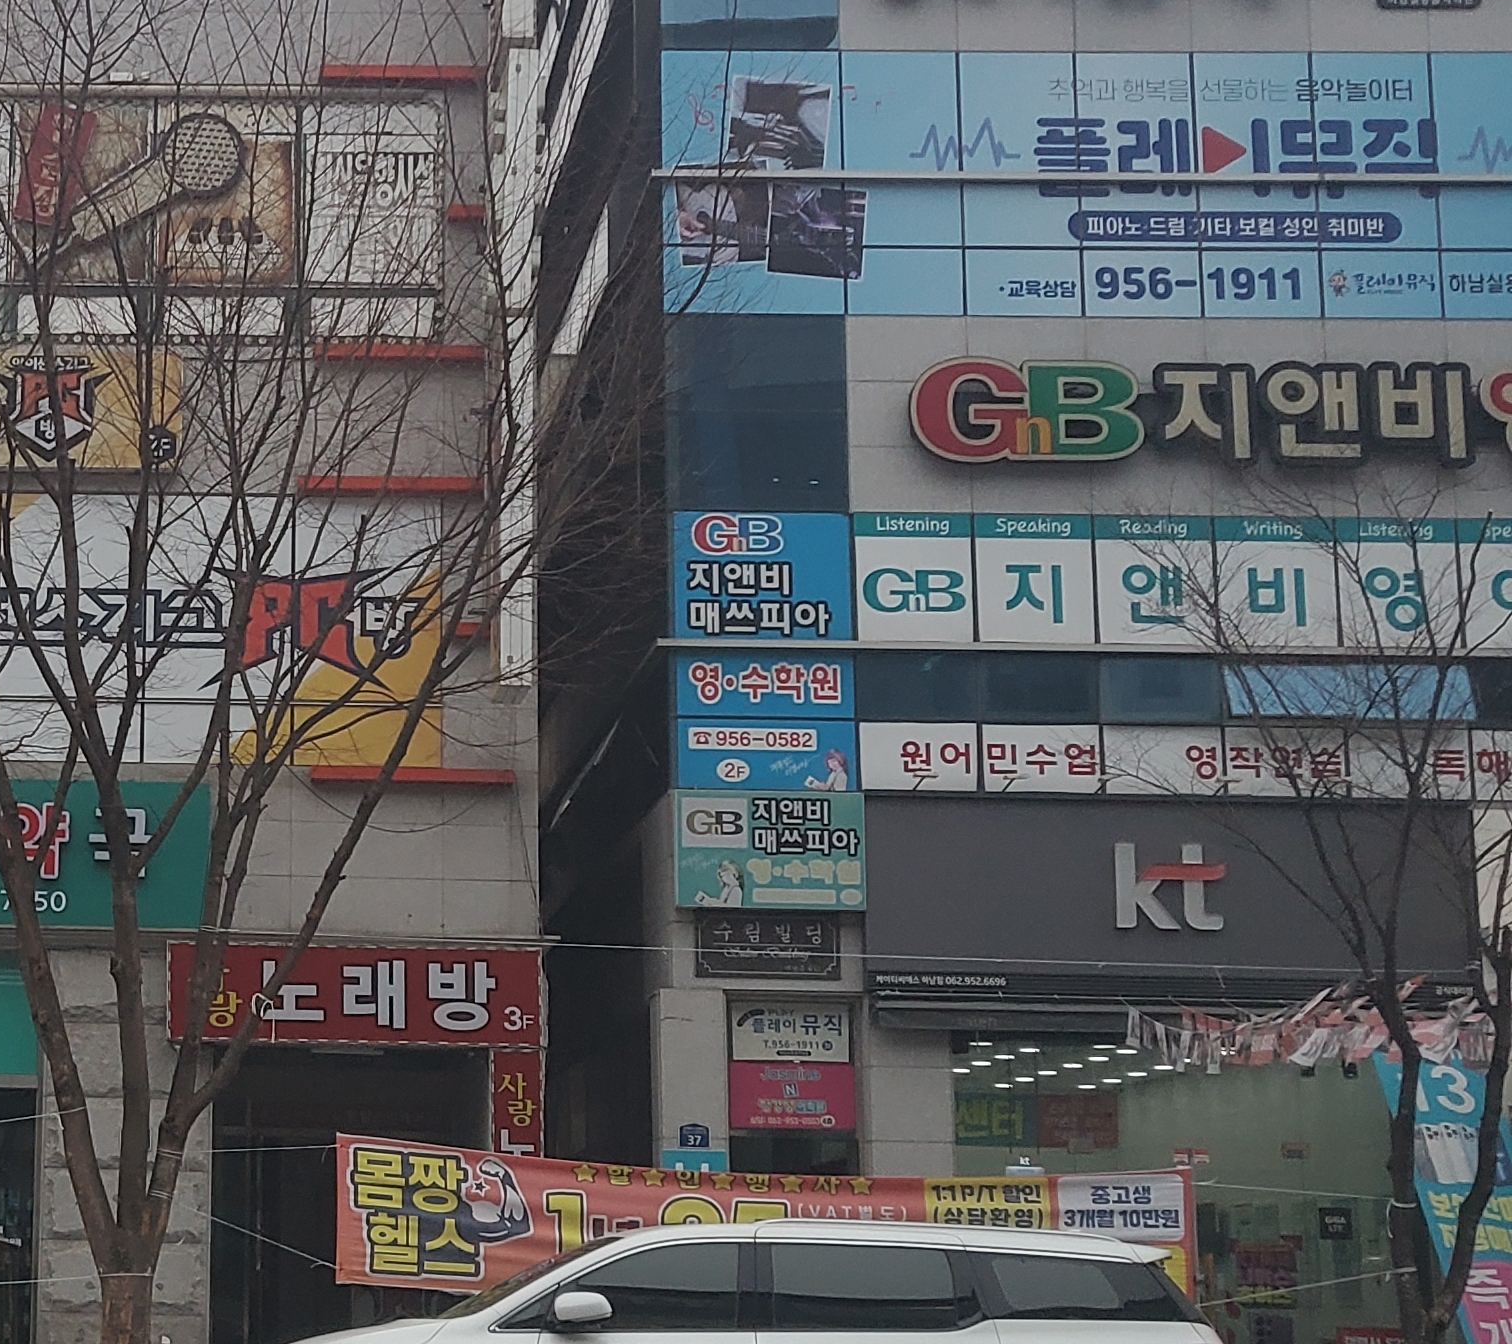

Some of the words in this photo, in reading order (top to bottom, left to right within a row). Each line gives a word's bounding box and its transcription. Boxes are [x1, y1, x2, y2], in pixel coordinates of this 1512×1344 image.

[1047, 78, 1118, 102] 추억과
[1123, 78, 1189, 102] 행복을
[1200, 78, 1288, 102] 선물하는
[1296, 78, 1413, 103] 음악놀이터
[1095, 266, 1302, 301] 956-1911
[911, 357, 1145, 463] GnB
[692, 513, 784, 555] GnB
[876, 518, 949, 534] Listening
[995, 519, 1071, 535] Speaking
[1119, 520, 1188, 536] Reading
[1245, 521, 1303, 539] Writing
[1359, 522, 1434, 540] Listenng
[688, 562, 791, 596] 지앤비
[689, 601, 830, 636] 매쓰피아
[716, 731, 814, 747] 956-0582
[723, 763, 746, 778] 2F
[753, 799, 830, 825] 지앤비
[754, 828, 859, 855] 매쓰피아
[1115, 843, 1226, 932] kt
[687, 1135, 702, 1146] 37
[352, 1150, 465, 1214] 몸짱
[1090, 1185, 1152, 1205] 중고생
[1063, 1209, 1116, 1229] 3개월
[1118, 1209, 1180, 1229] 10만원
[369, 1212, 476, 1275] 헬스
